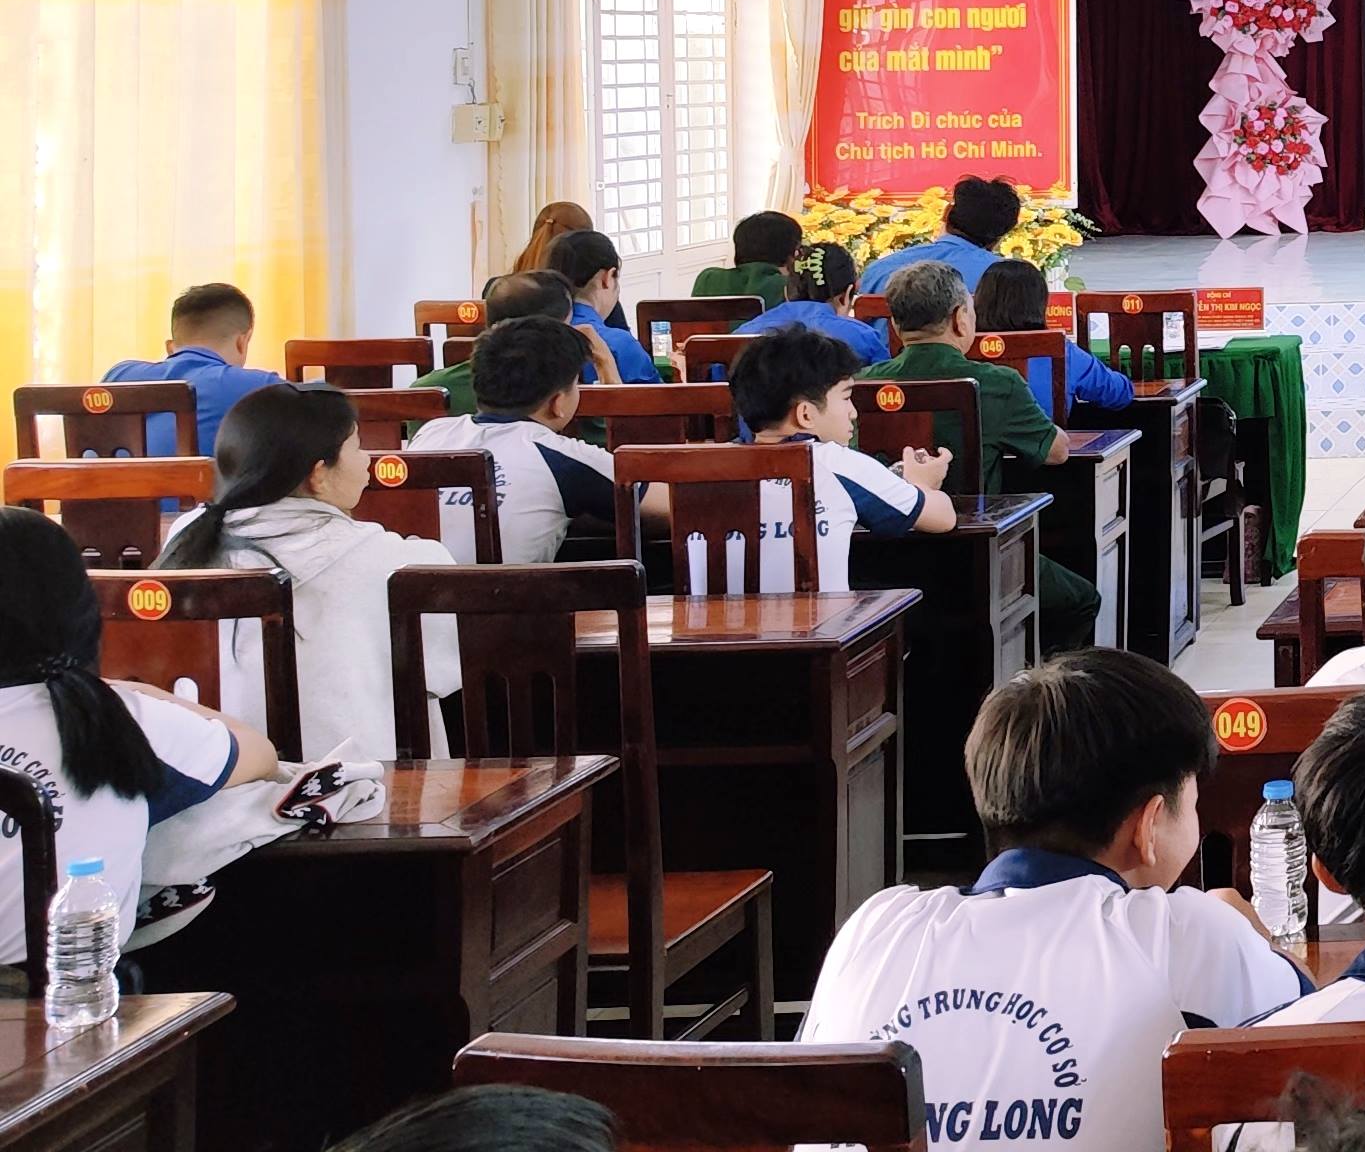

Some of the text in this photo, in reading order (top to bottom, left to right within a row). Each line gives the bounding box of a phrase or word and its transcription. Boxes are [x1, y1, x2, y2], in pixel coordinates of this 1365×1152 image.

[983, 340, 1002, 353] 046
[86, 392, 110, 409] 100
[879, 391, 902, 406] 044
[378, 462, 404, 479] 004
[133, 589, 166, 611] 009
[1218, 711, 1261, 739] 049
[917, 988, 1004, 1020] TRUNG
[1001, 993, 1048, 1029] HỌC
[1038, 1022, 1074, 1055] CƠ
[979, 1098, 1083, 1140] LONG
